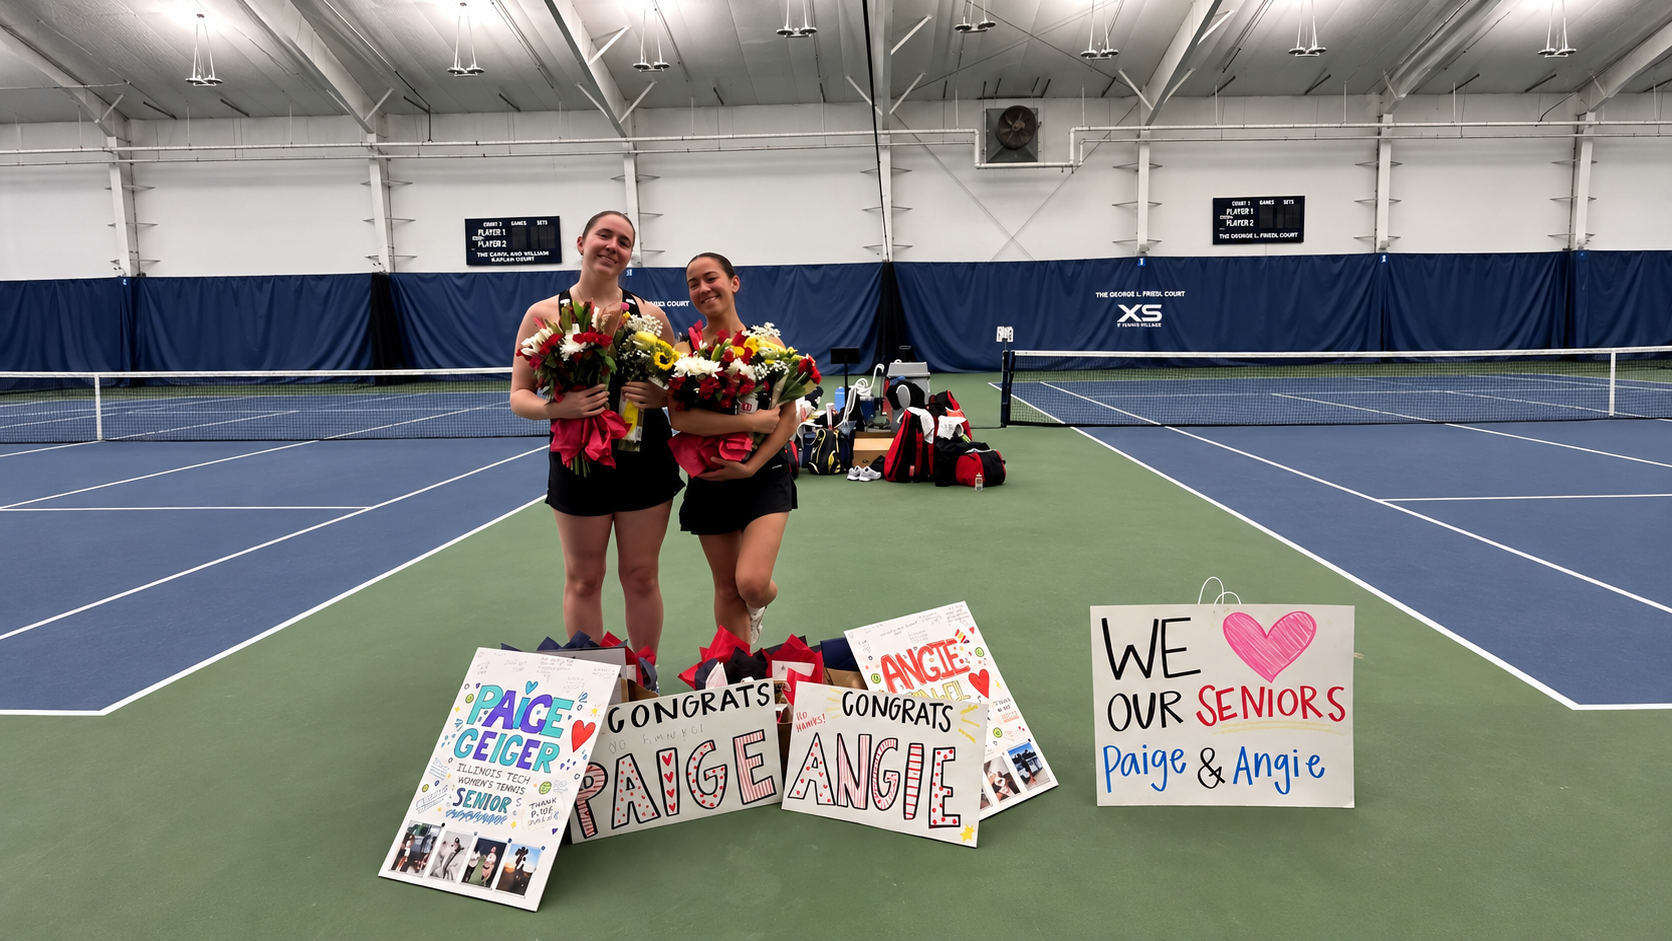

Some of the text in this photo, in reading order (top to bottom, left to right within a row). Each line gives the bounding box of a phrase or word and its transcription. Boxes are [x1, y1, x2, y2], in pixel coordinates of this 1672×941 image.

[1117, 304, 1162, 322] XS
[880, 638, 971, 694] ANGIE
[1101, 617, 1201, 680] WE
[466, 684, 575, 738] PAIGE
[608, 682, 770, 734] CONGRATS
[842, 691, 953, 732] CONGRATS
[1107, 684, 1346, 732] OUR SENIORS
[453, 728, 560, 774] GEIGER
[456, 763, 502, 779] ILLINOIS
[507, 772, 531, 785] TECH
[1103, 744, 1325, 795] Paige & Angie
[452, 788, 512, 814] SENIOR
[496, 782, 526, 795] TENNIS
[574, 729, 777, 839] PAIGE
[788, 732, 960, 829] ANGIE
